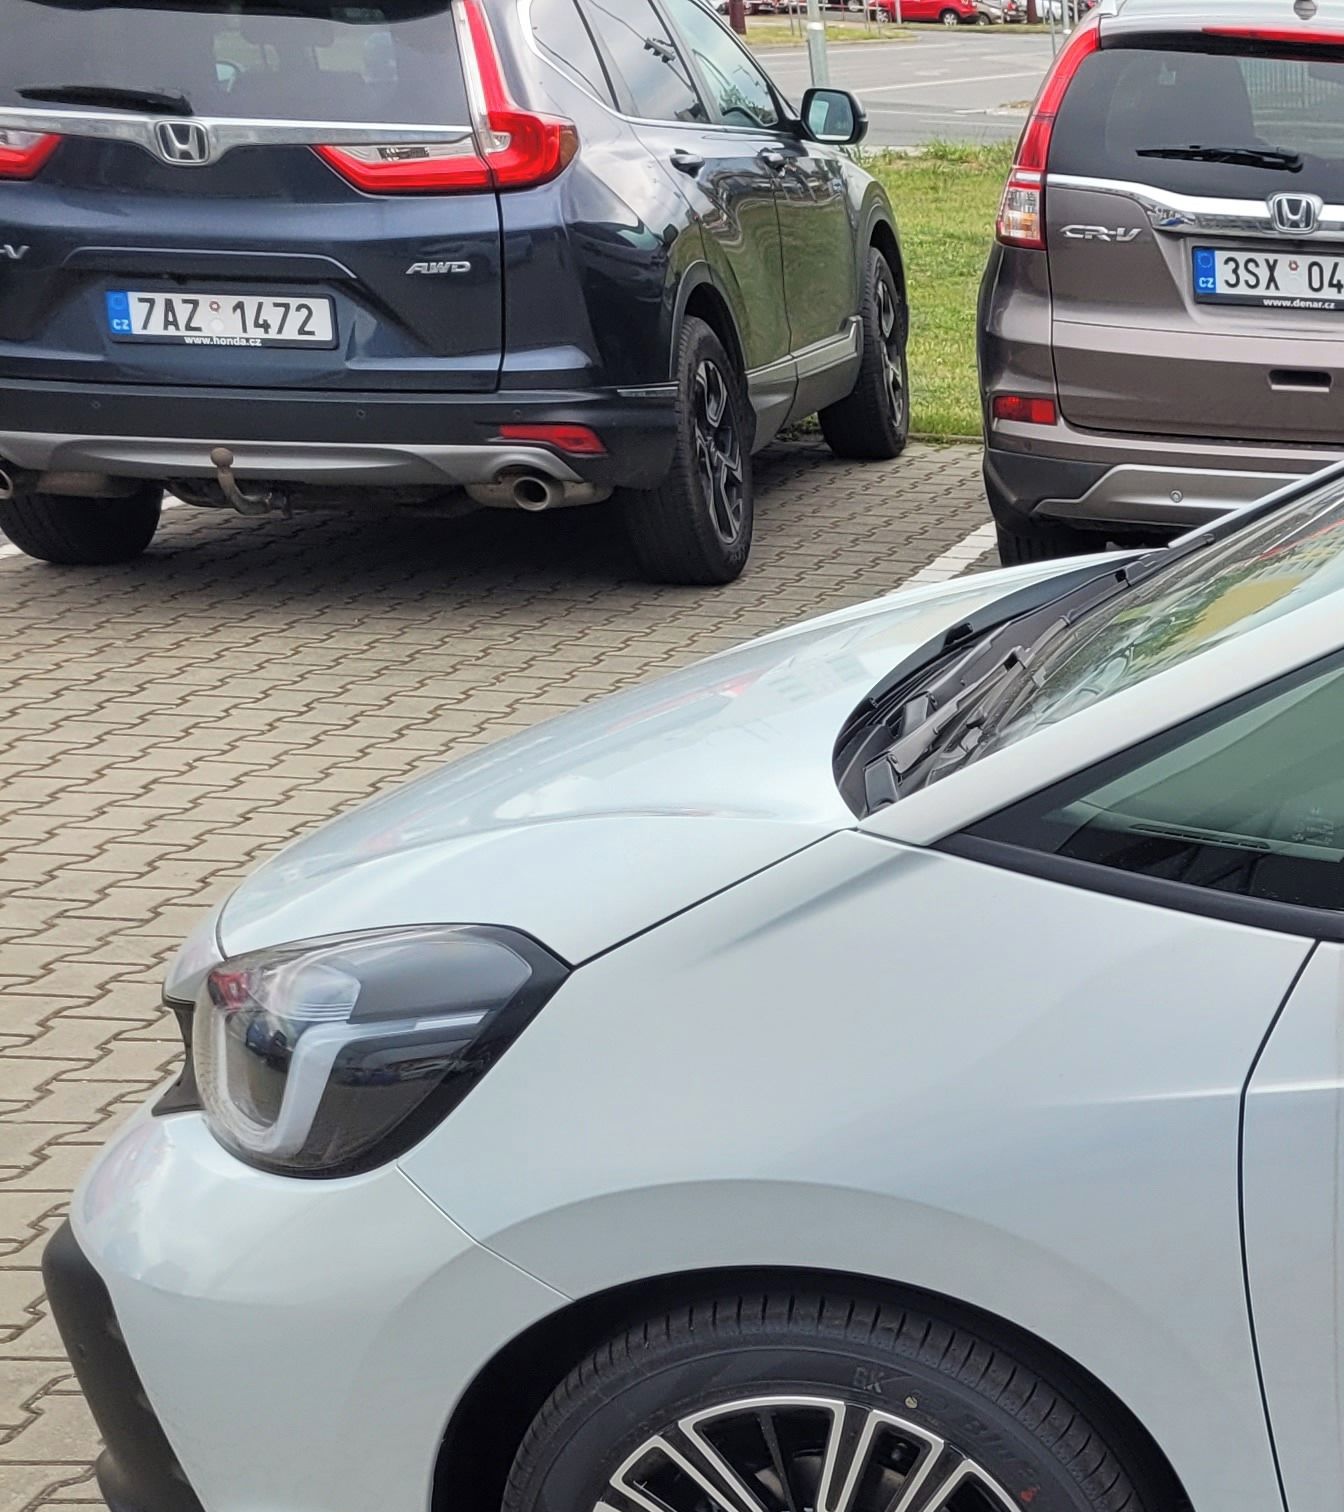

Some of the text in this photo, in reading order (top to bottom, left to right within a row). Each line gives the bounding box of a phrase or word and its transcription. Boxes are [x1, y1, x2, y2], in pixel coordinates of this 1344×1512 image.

[1060, 224, 1142, 242] CR-V
[405, 261, 471, 275] AWD
[1199, 276, 1215, 288] CZ
[1223, 256, 1280, 291] 3SX
[1263, 298, 1335, 310] www.denar.cz
[112, 297, 316, 336] CZ 7AZ 1472
[184, 335, 262, 347] www.honda.cz
